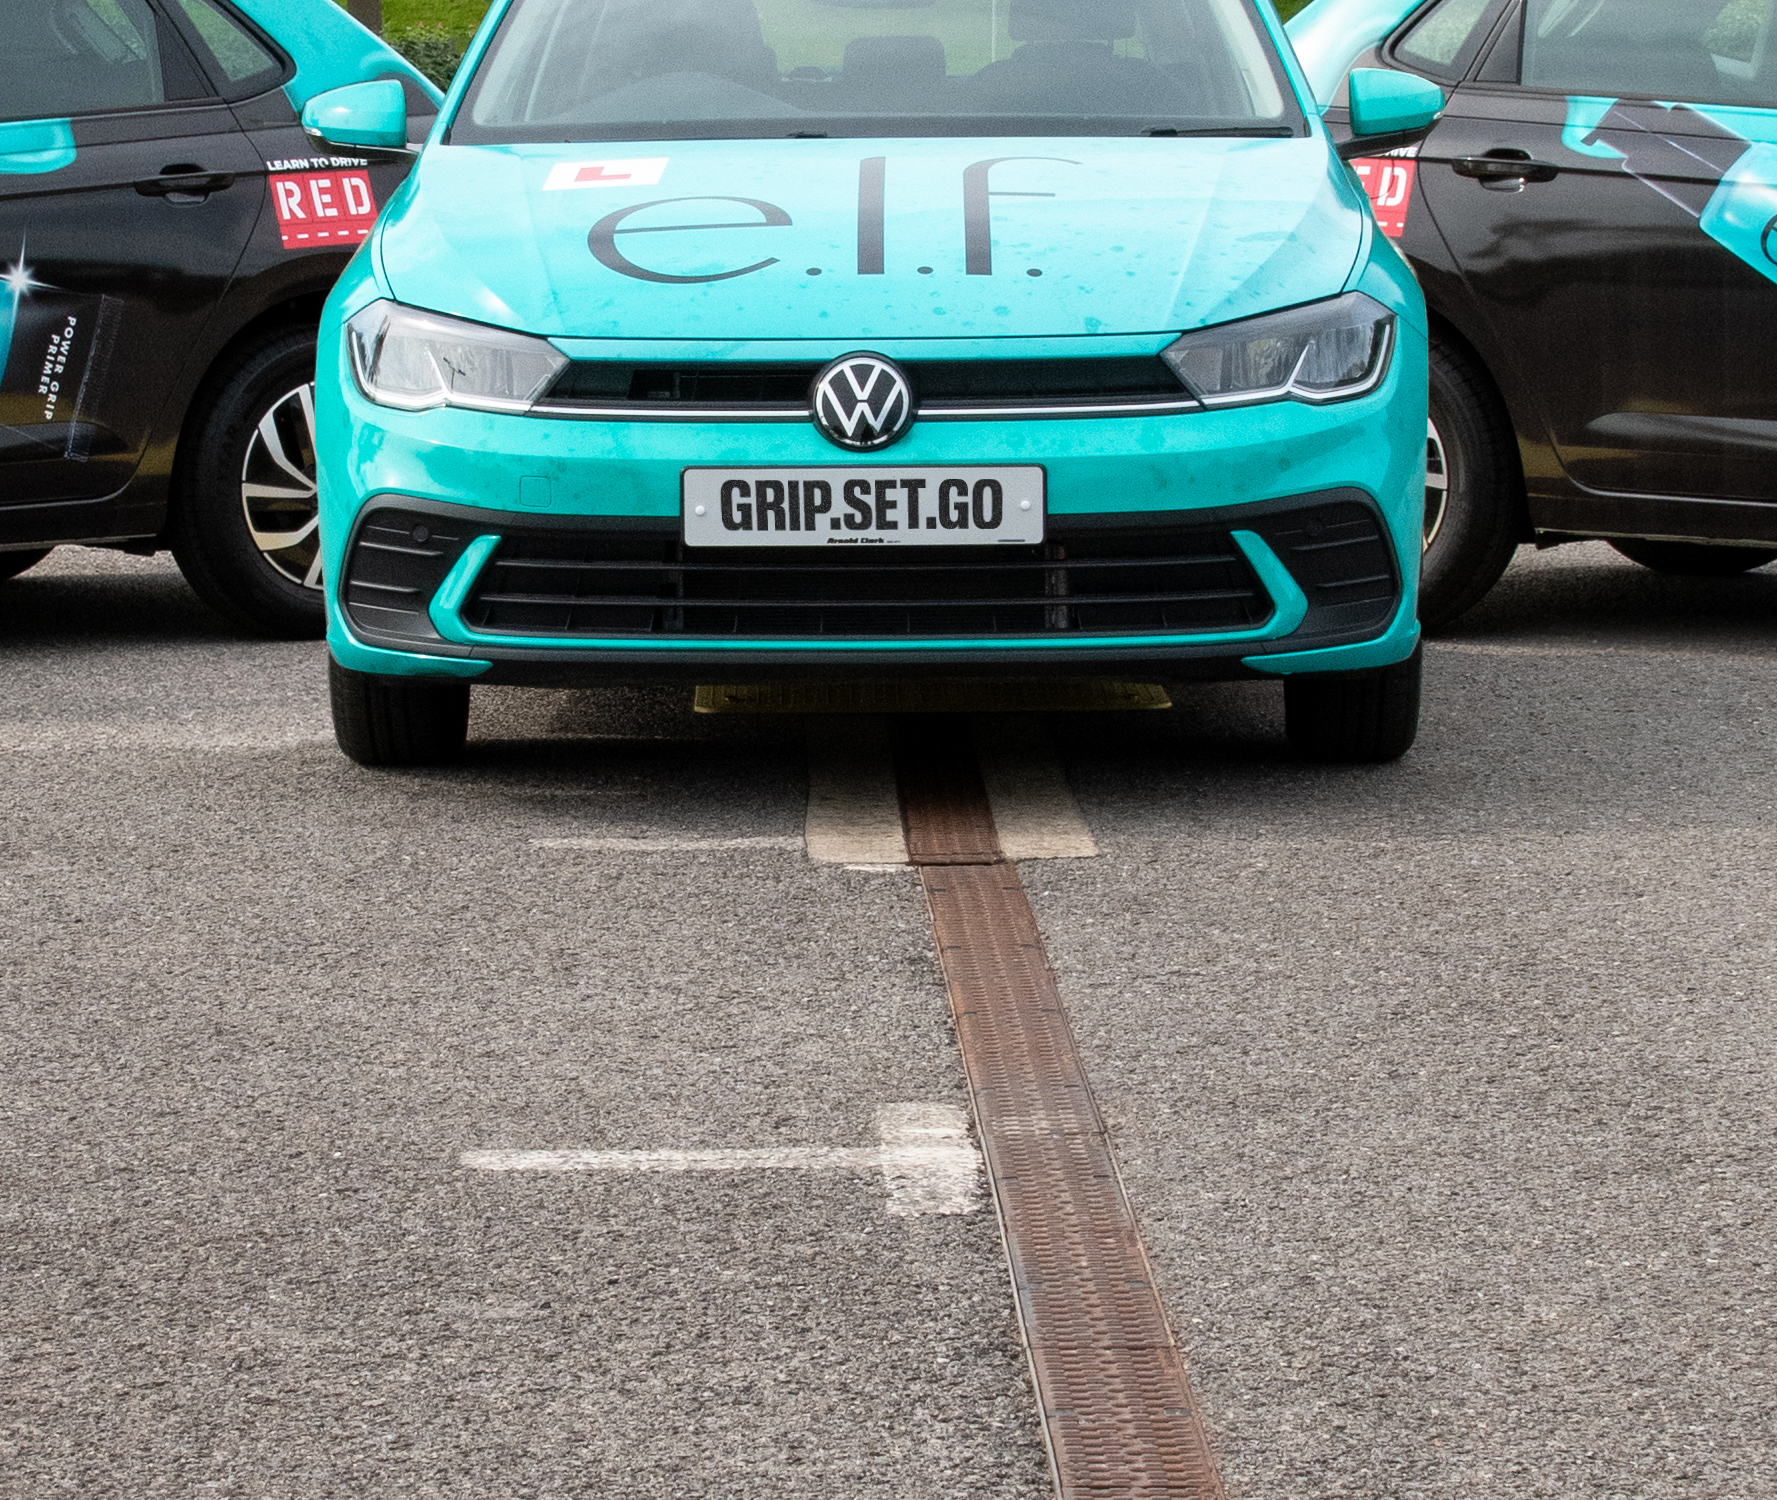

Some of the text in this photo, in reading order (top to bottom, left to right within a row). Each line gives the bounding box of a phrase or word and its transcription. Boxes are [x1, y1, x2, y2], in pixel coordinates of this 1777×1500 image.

[266, 156, 368, 171] LEARN TO DRIVE
[573, 166, 632, 183] L
[275, 177, 371, 220] RED
[587, 155, 1084, 284] e.l.f.
[38, 334, 61, 394] PRIMER
[44, 316, 77, 420] POWER GRIP
[720, 478, 1004, 532] GRIP.SET.GO
